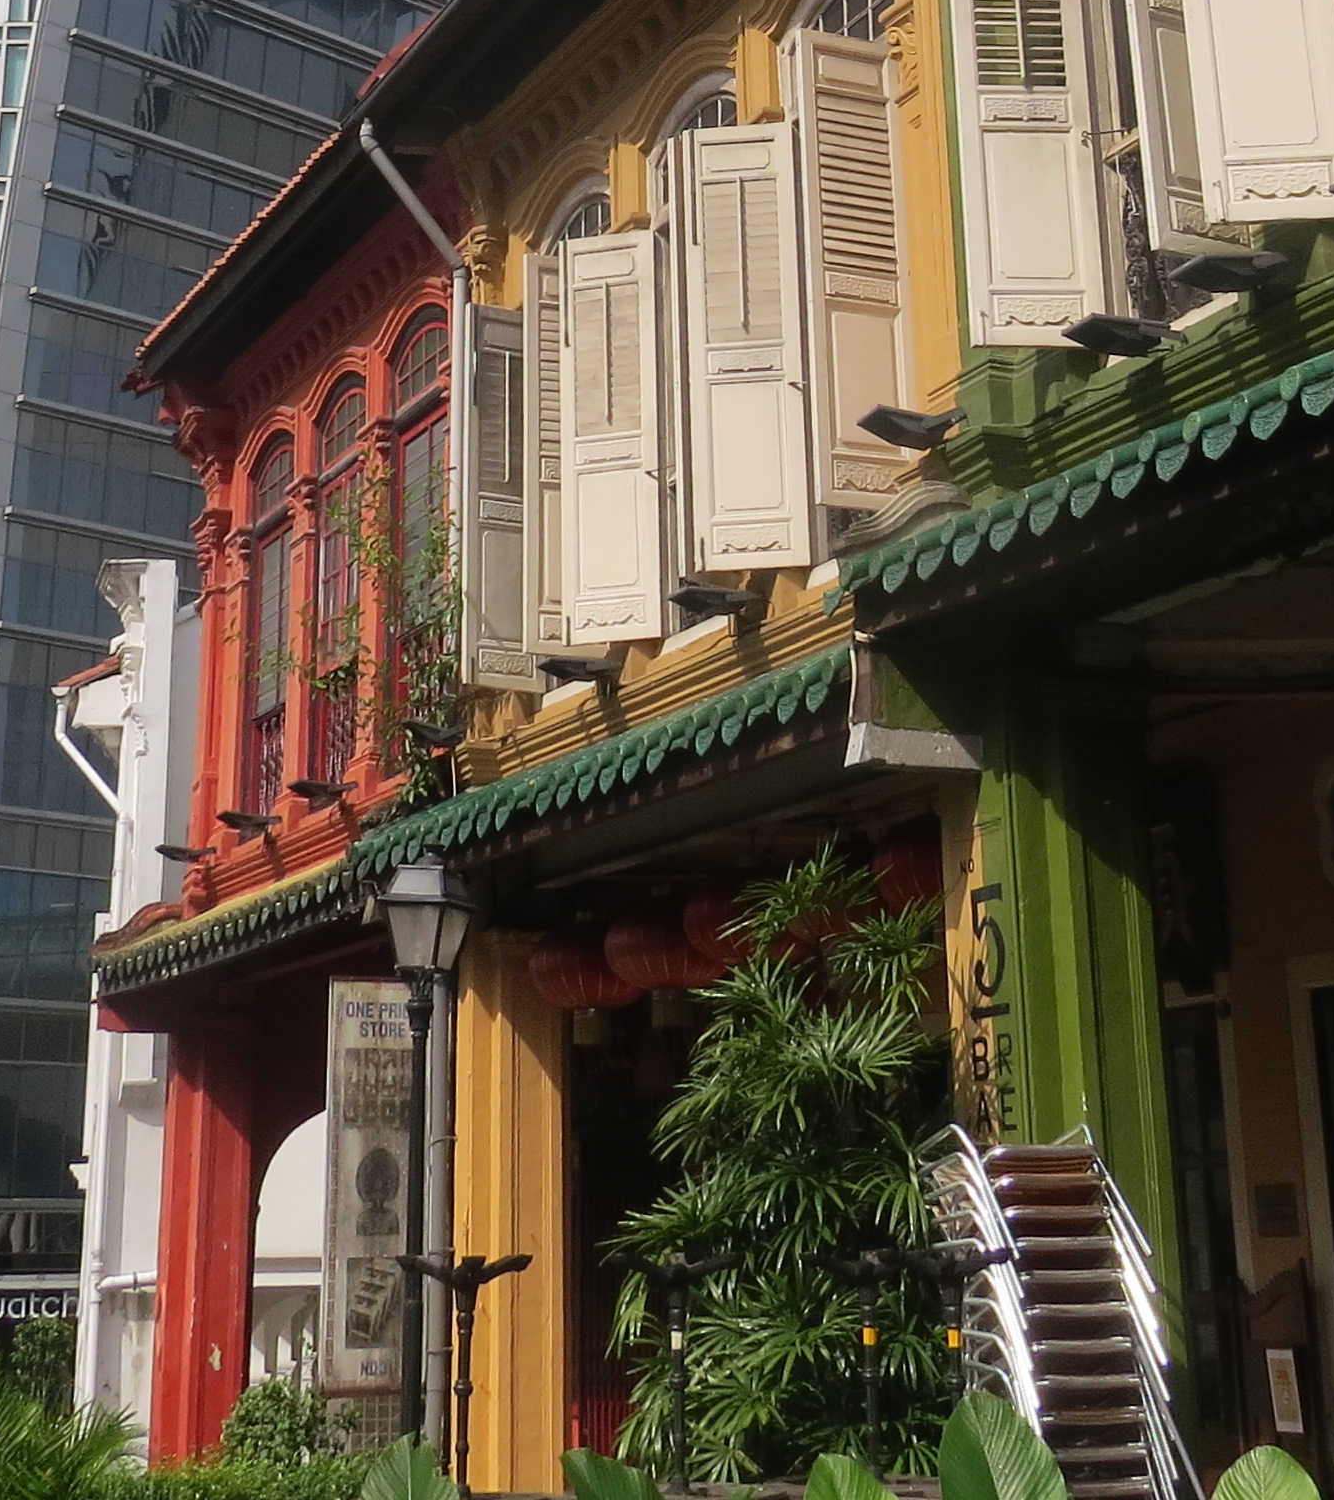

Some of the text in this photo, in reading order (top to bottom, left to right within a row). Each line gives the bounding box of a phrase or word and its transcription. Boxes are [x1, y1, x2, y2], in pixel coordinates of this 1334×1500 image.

[971, 882, 1006, 998] 5
[346, 1002, 375, 1018] ONE
[360, 1021, 406, 1037] STORE
